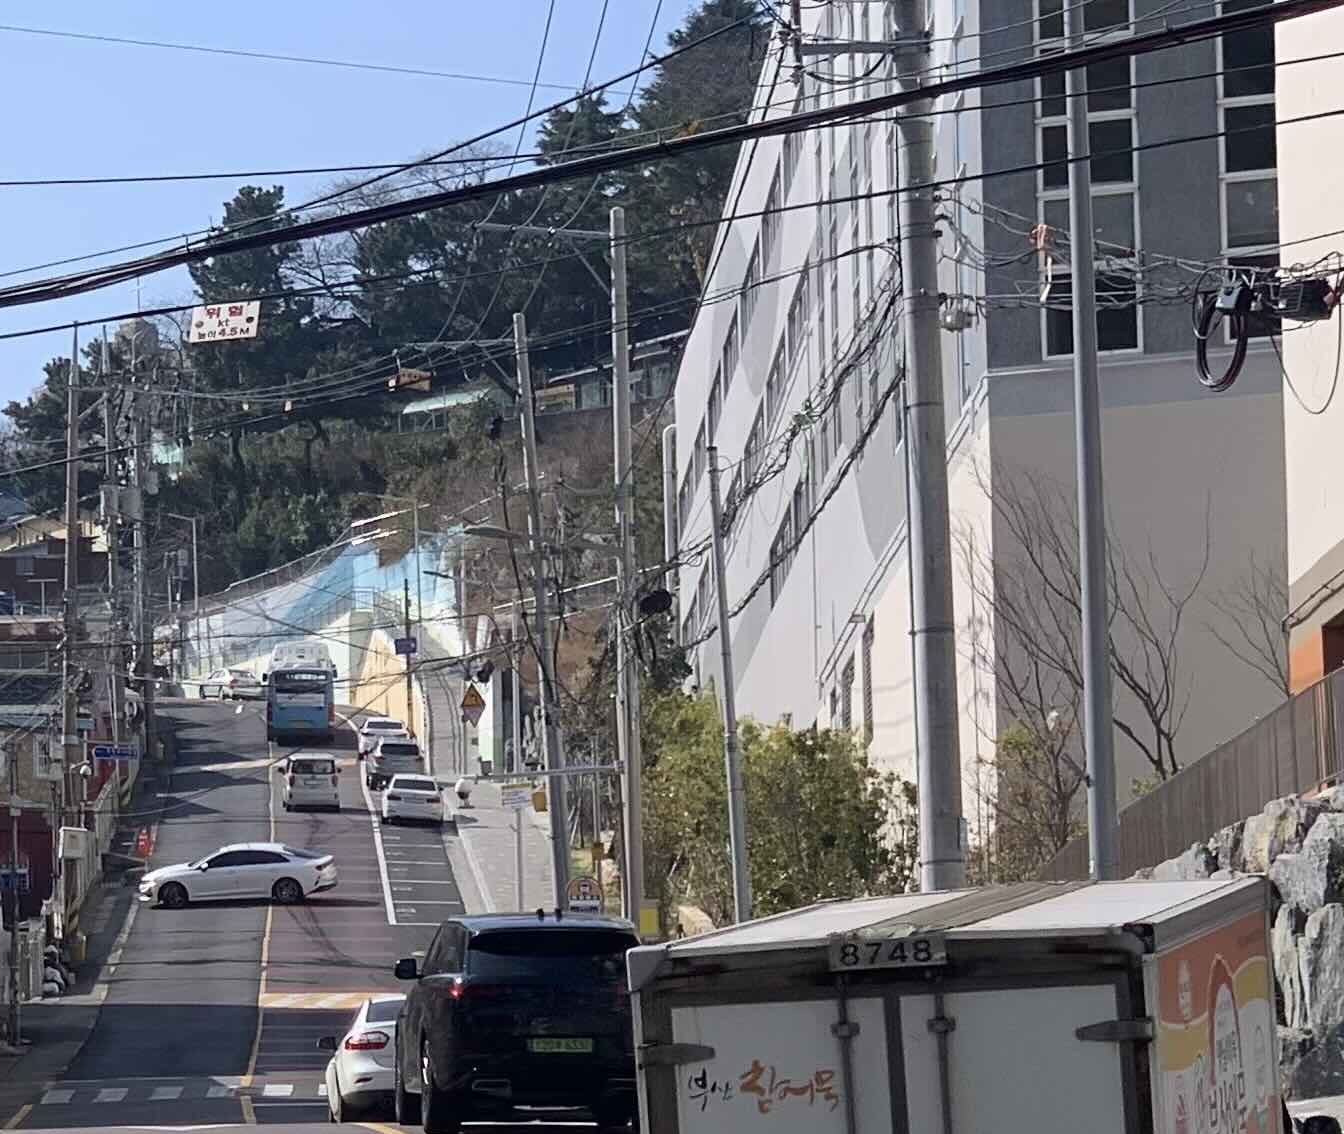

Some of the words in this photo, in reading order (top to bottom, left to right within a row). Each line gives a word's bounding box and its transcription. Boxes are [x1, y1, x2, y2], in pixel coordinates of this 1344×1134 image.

[217, 318, 230, 327] kt
[839, 940, 931, 967] 8748
[688, 1068, 734, 1112] 부산
